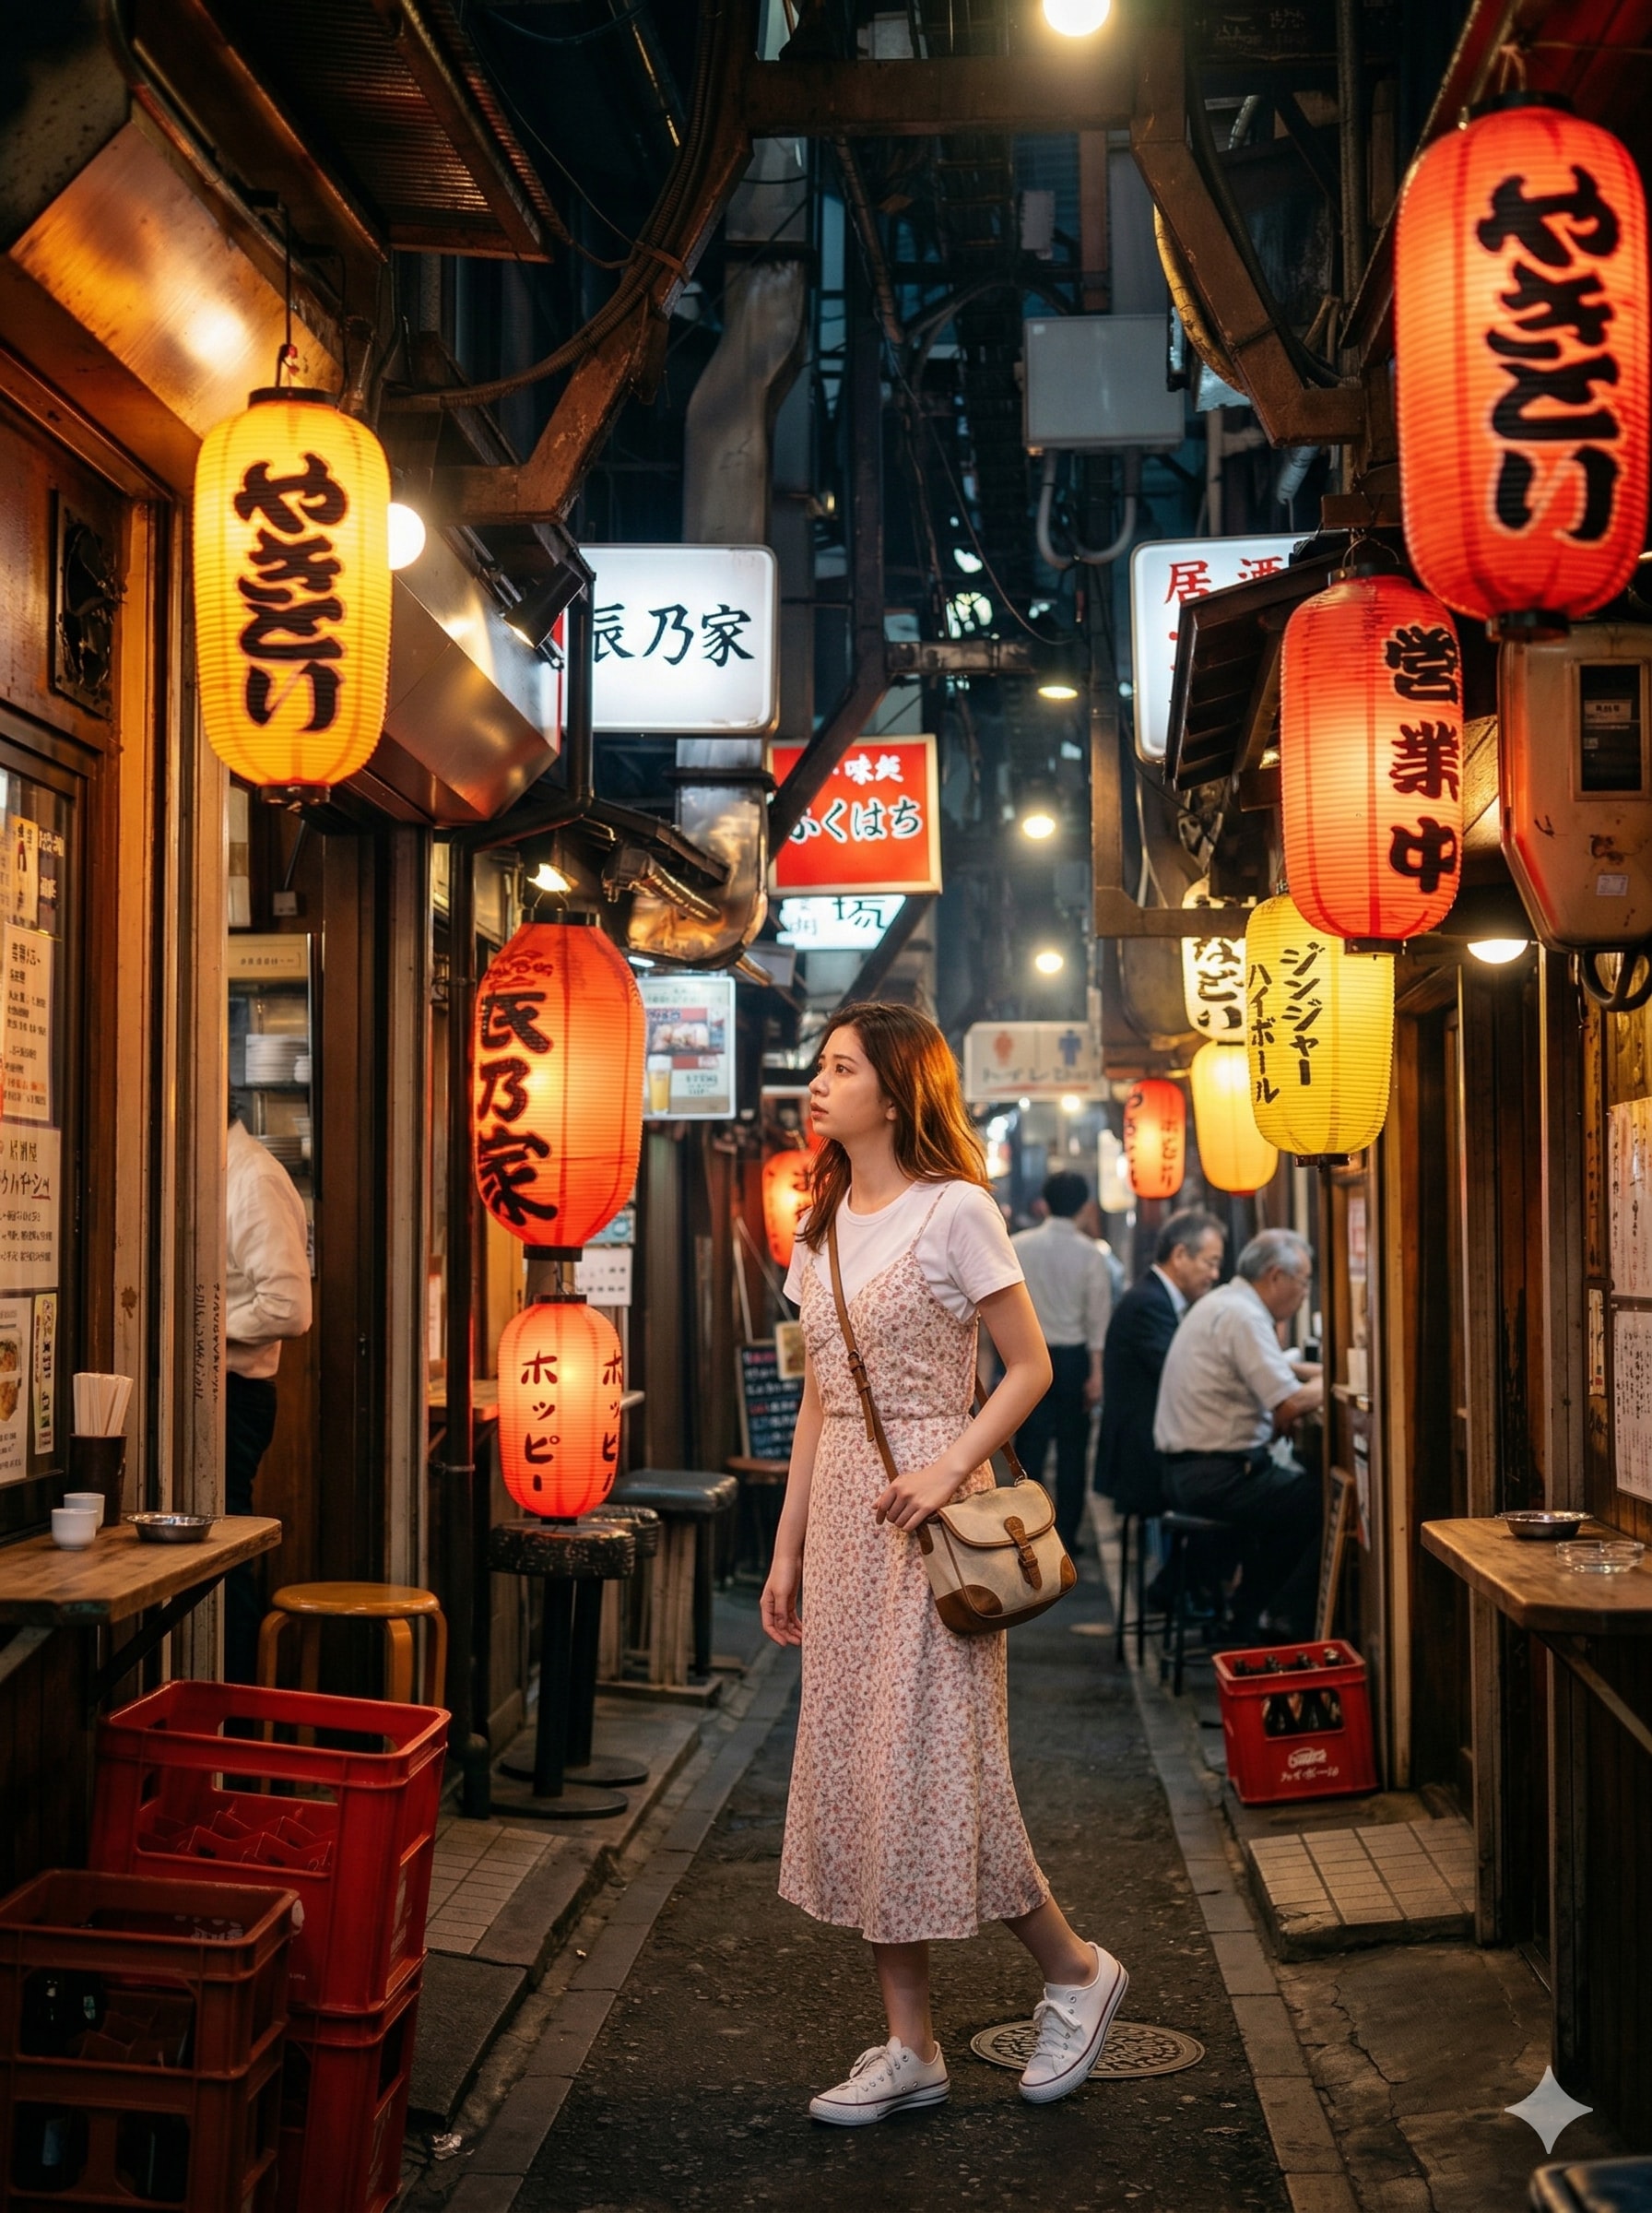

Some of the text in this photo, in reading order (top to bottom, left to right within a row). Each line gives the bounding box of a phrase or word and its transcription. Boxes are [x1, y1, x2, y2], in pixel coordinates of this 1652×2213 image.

[1477, 164, 1623, 546] やきとり
[232, 451, 350, 734] やきとり
[1384, 624, 1460, 894] 営業中
[1247, 963, 1280, 1105] ハイボール
[1279, 941, 1327, 1086] ジンジャー
[520, 1349, 560, 1492] ホッピー
